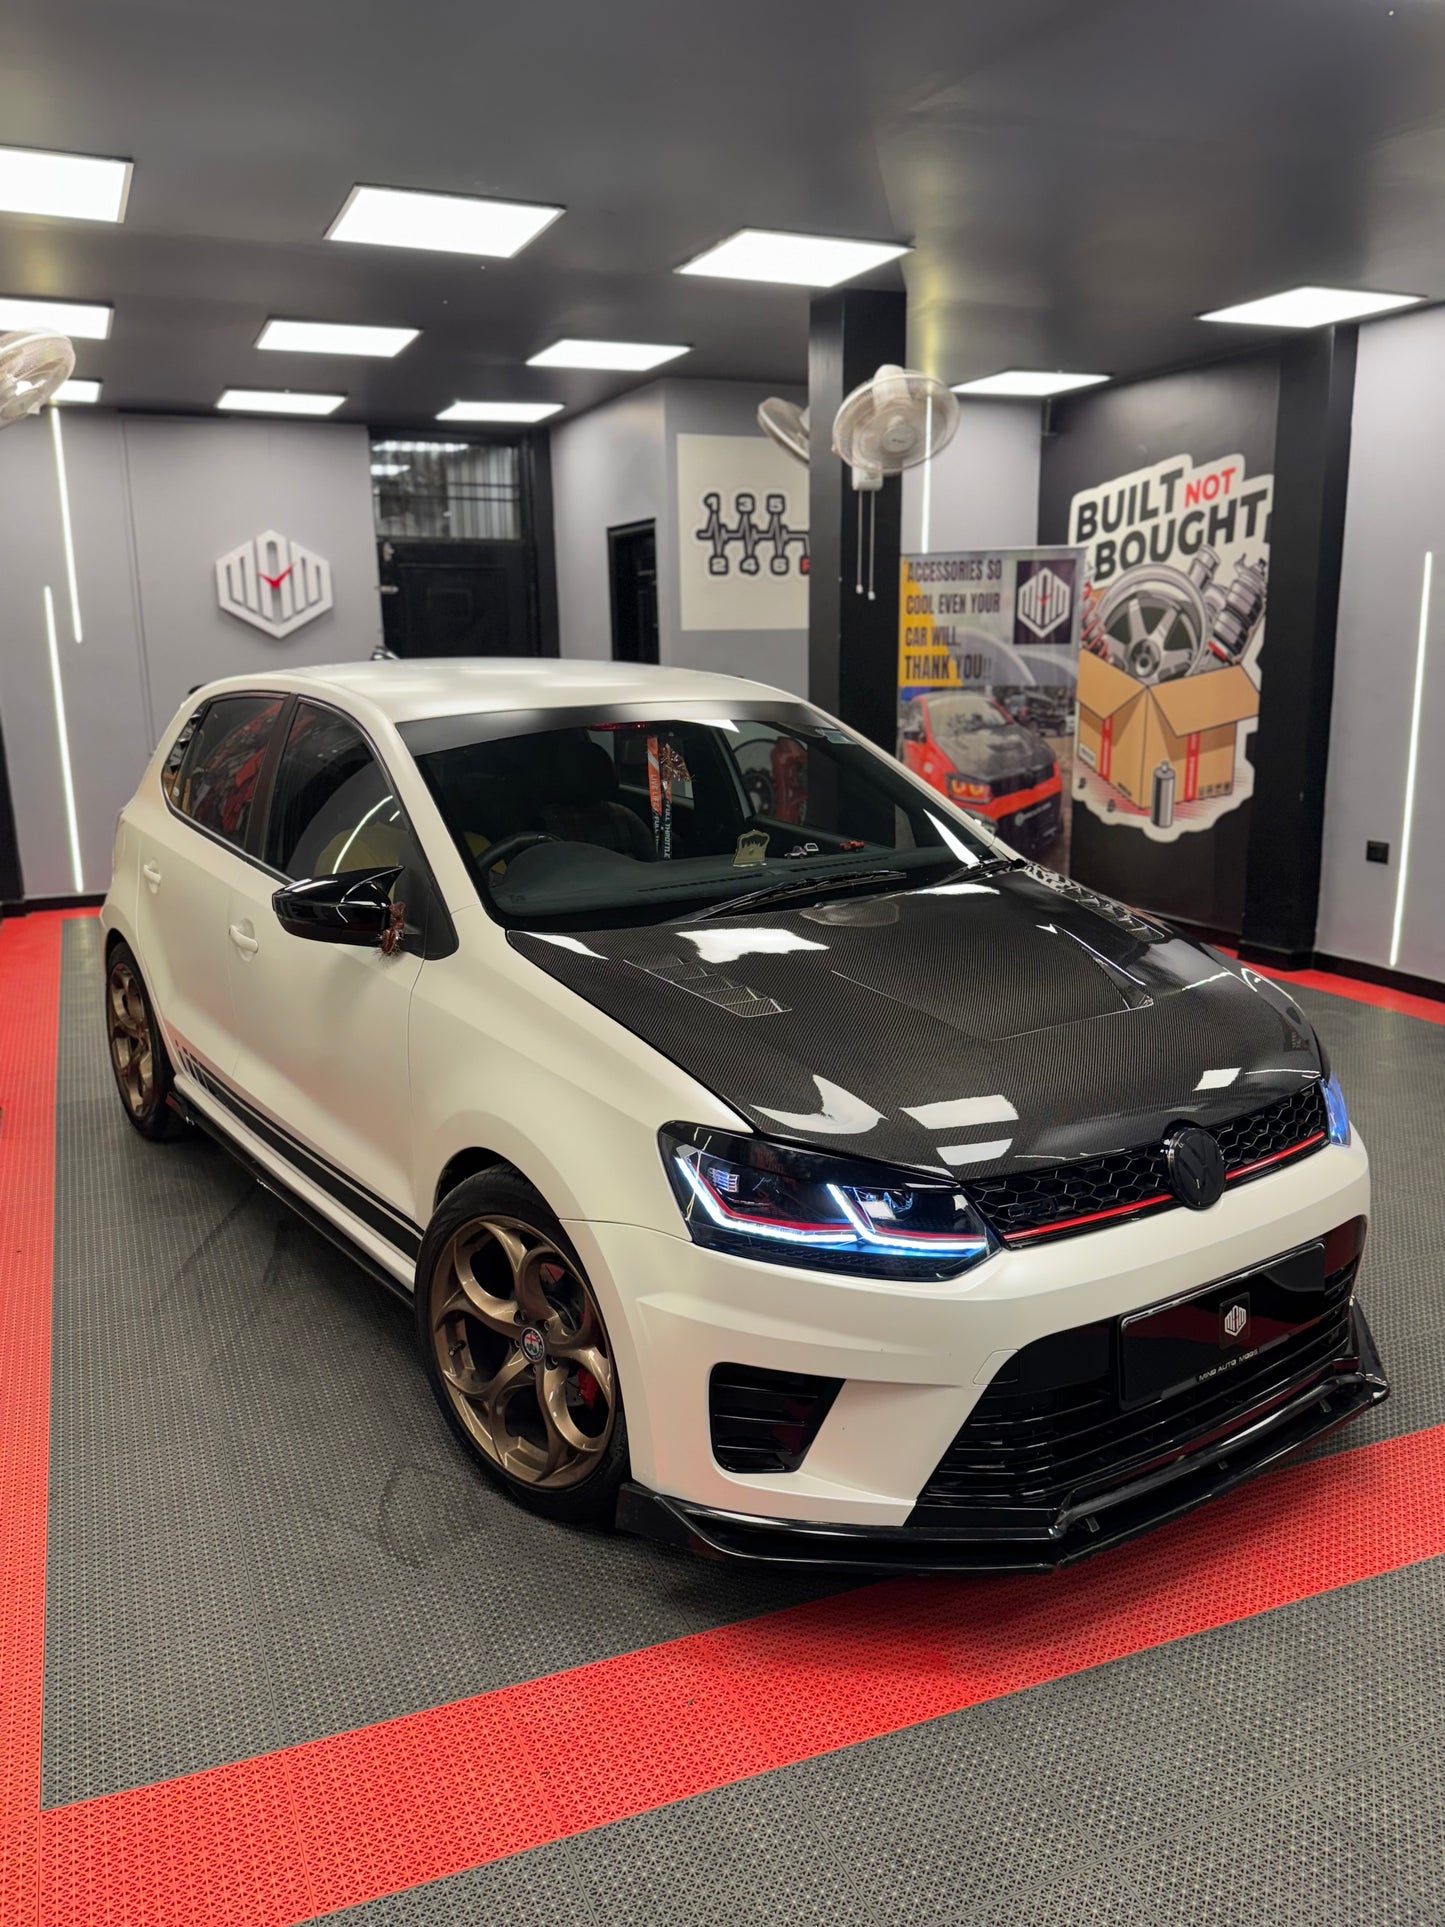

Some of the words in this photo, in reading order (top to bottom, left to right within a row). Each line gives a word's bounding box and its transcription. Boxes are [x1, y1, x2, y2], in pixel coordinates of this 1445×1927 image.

[1076, 467, 1184, 543] BUILT
[1185, 467, 1236, 508] NOT
[1094, 488, 1268, 582] BOUGHT
[907, 560, 982, 582] ACCESSORIES
[987, 560, 1002, 580] SO
[906, 594, 935, 615] COOL
[938, 593, 966, 614] EVEN
[971, 592, 1000, 613] YOUR
[905, 627, 930, 647] CAR
[905, 655, 950, 680] THANK
[956, 653, 992, 680] YOU!!
[1218, 1359, 1237, 1373] AUTO
